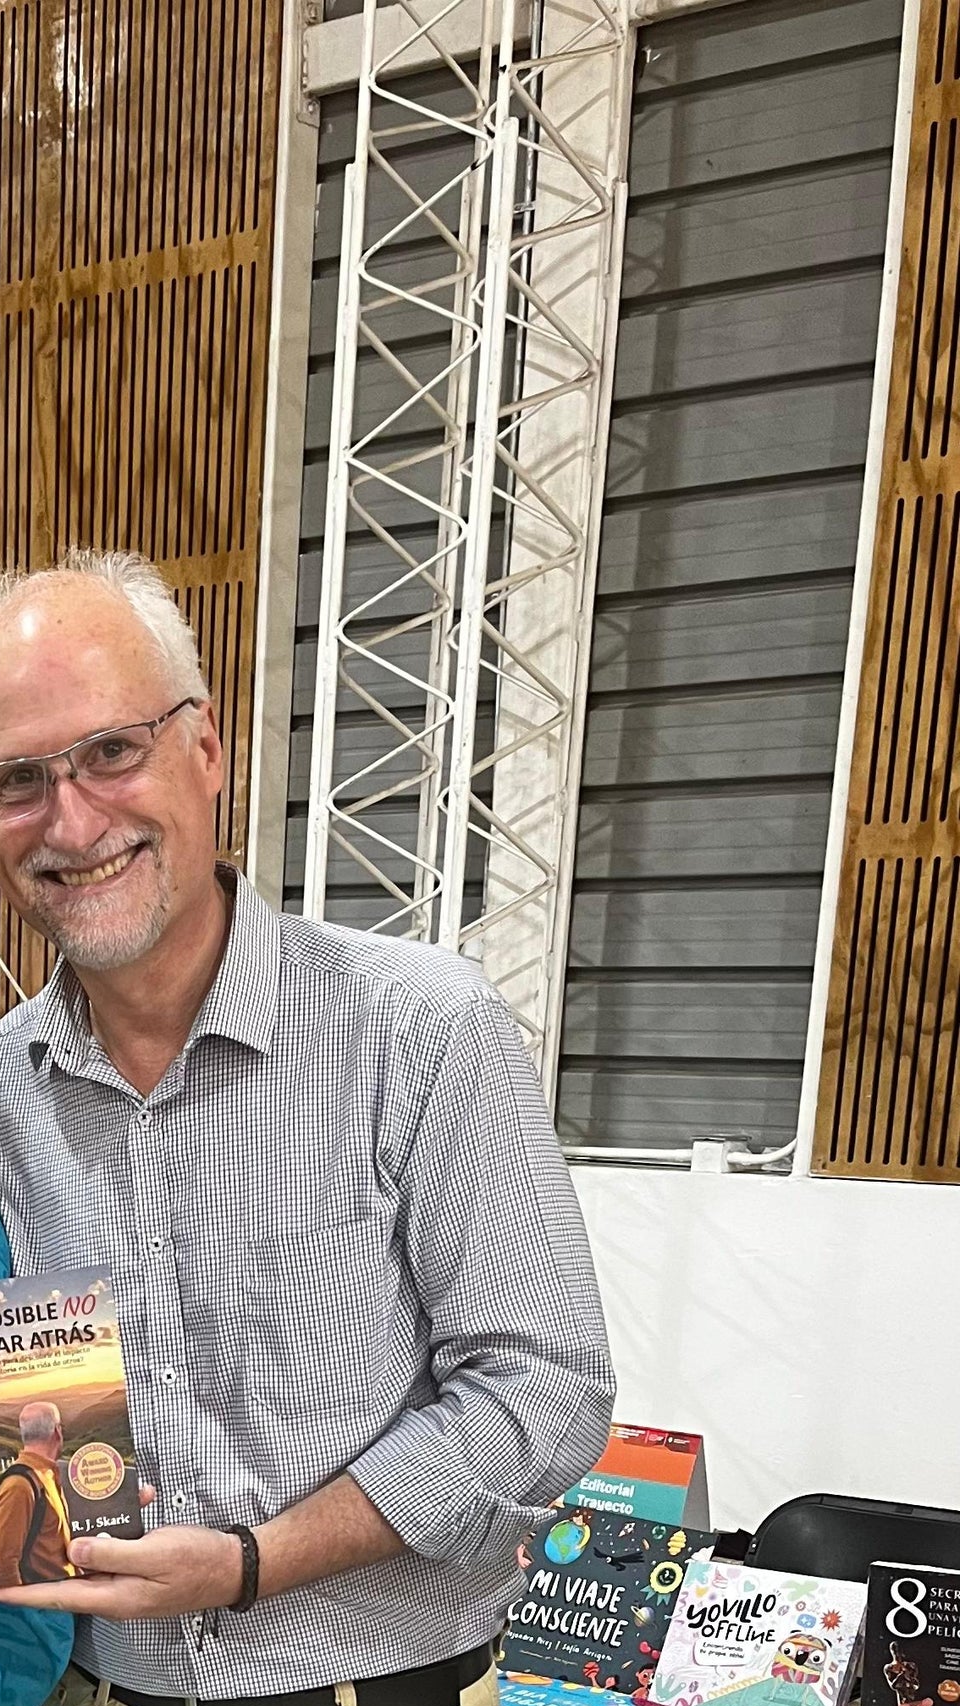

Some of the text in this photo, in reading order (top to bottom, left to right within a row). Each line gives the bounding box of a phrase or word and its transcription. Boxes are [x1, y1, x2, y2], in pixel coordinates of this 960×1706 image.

[63, 1294, 96, 1319] NO
[29, 1321, 96, 1350] ATRÁS
[580, 1477, 635, 1498] Editorial
[577, 1494, 634, 1515] Trayecto
[71, 1520, 84, 1532] R.
[85, 1519, 95, 1532] J.
[529, 1569, 626, 1614] MI VIAJE
[885, 1577, 928, 1638] 8
[928, 1612, 950, 1622] UNA
[929, 1600, 959, 1613] PARA
[507, 1597, 629, 1648] CONSCIENTE
[701, 1620, 776, 1644] OFFLINE
